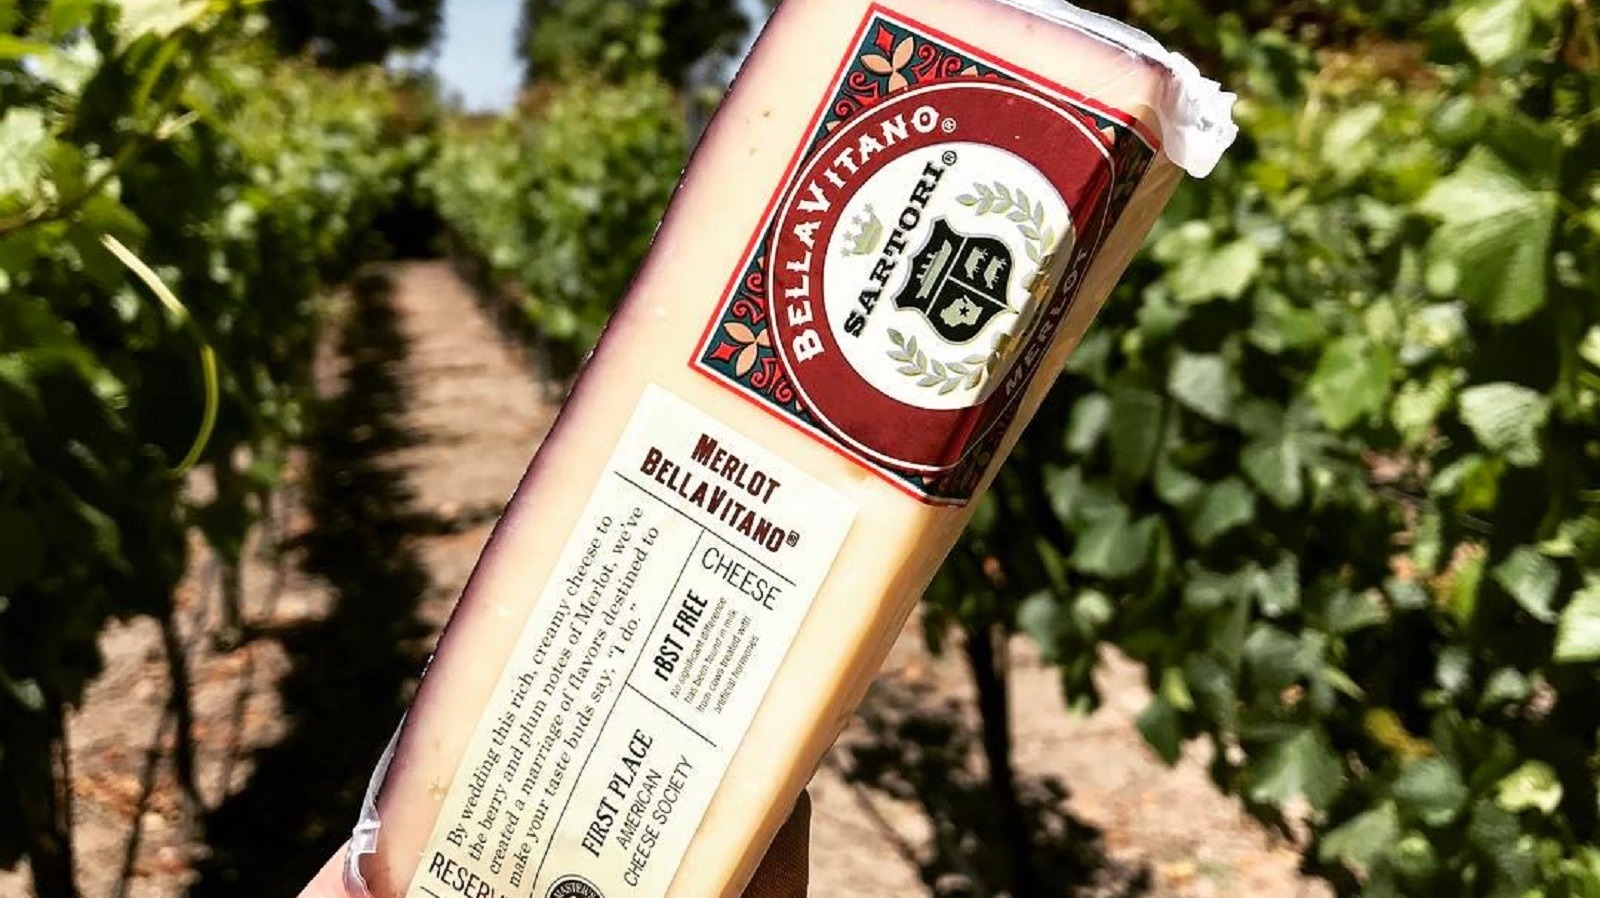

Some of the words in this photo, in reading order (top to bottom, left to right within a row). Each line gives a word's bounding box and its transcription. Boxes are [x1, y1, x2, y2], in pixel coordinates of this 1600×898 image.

[1005, 250, 1087, 395] MERLOT
[691, 433, 781, 504] MERLOT
[701, 547, 782, 611] CHEESE
[569, 622, 582, 645] of
[653, 633, 684, 682] rBST
[672, 589, 708, 637] FREE
[446, 823, 468, 847] By
[461, 748, 501, 819] wedding
[492, 711, 515, 746] this
[533, 599, 571, 665] creamy
[566, 538, 601, 596] cheese
[596, 516, 613, 534] to
[489, 810, 520, 875] created
[515, 799, 526, 811] a
[521, 714, 563, 796] marriage
[560, 688, 574, 712] of
[568, 629, 607, 691] flavors
[601, 547, 648, 626] destined
[642, 527, 659, 546] to
[543, 648, 572, 696] notes
[519, 700, 547, 748] plum
[503, 745, 524, 783] and
[509, 842, 531, 888] make
[526, 799, 549, 844] your
[544, 752, 570, 797] taste
[563, 705, 595, 749] buds
[581, 796, 619, 858] FIRST
[607, 729, 653, 800] PLACE
[477, 783, 507, 830] berry
[616, 768, 662, 850] AMERICAN
[623, 824, 660, 887] CHEESE
[652, 755, 693, 825] SOCIETY
[468, 833, 487, 861] the
